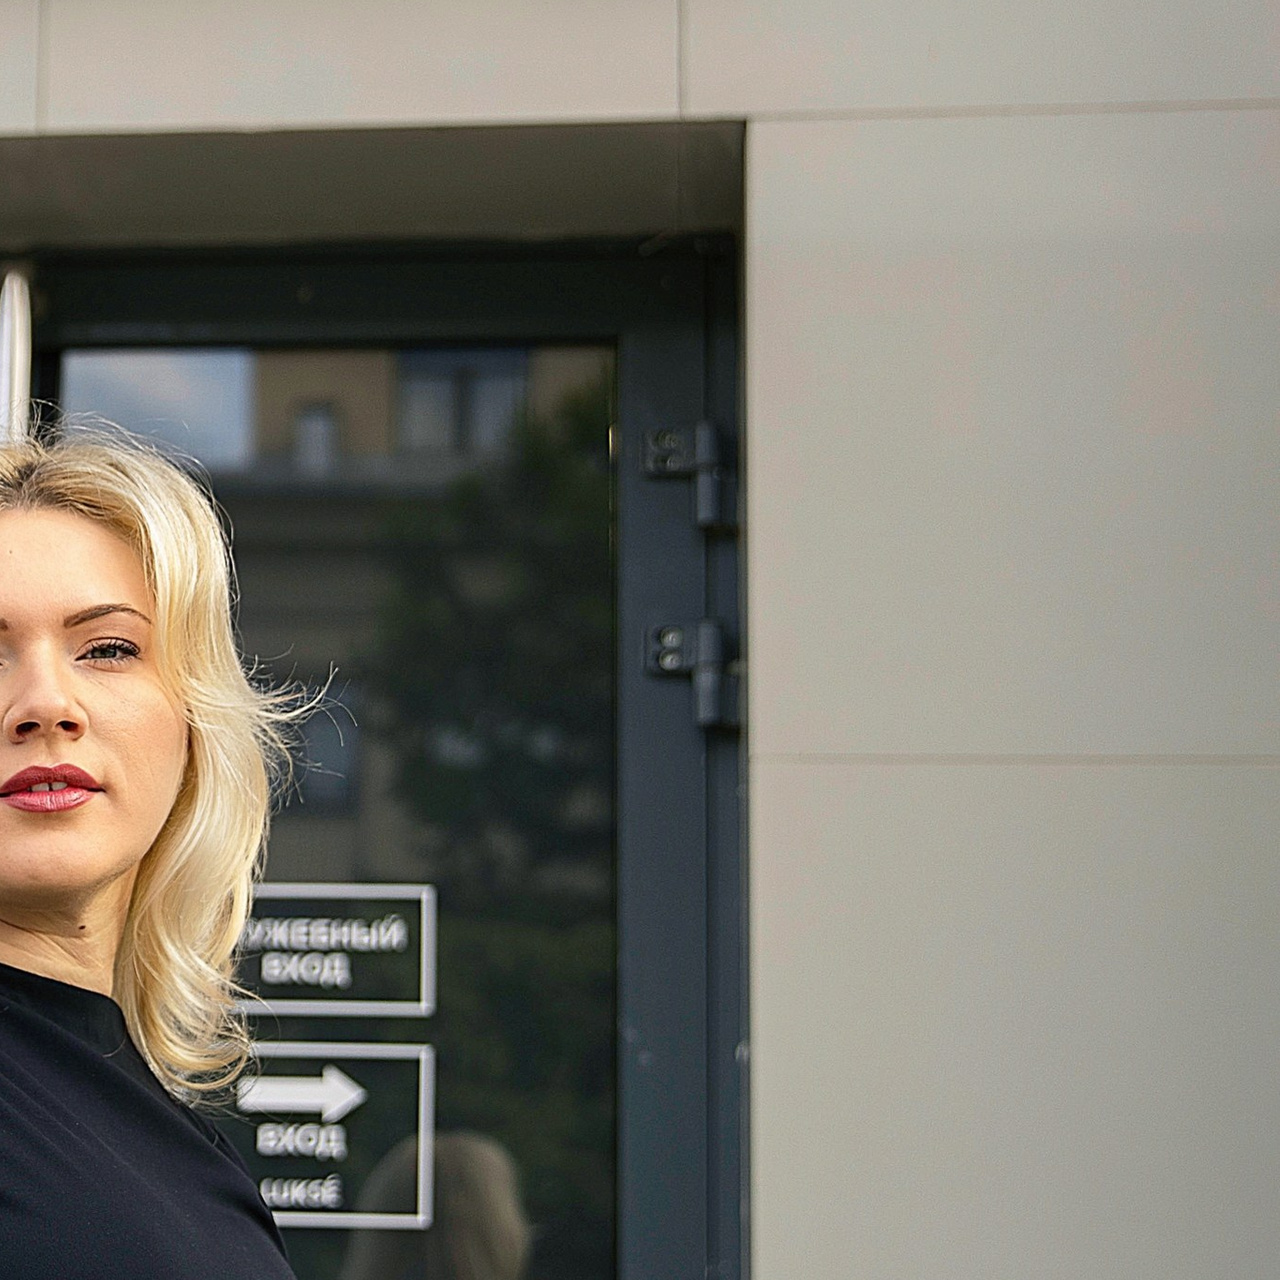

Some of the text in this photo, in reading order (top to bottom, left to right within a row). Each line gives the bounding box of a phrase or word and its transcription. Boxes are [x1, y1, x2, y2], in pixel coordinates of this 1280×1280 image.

[246, 914, 408, 952] УЖЕБНЫЙ
[261, 952, 352, 989] ВХОД
[256, 1123, 347, 1161] ВХОД
